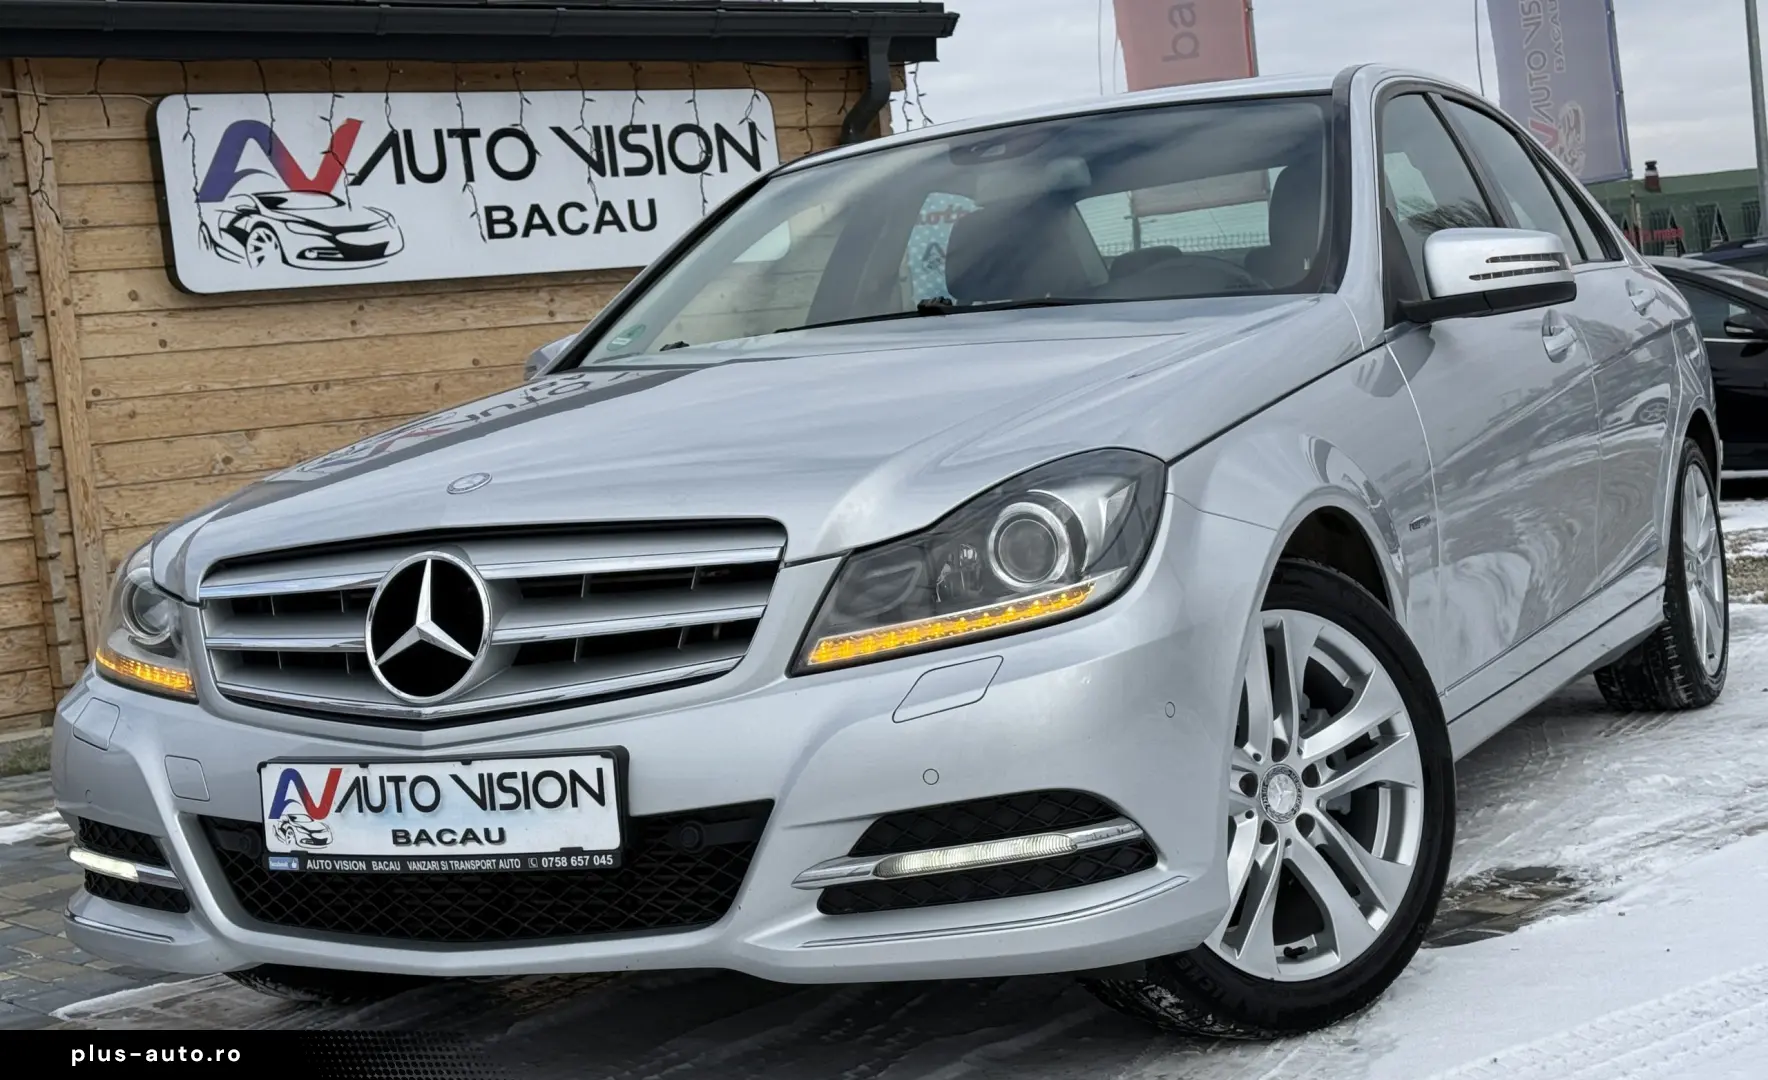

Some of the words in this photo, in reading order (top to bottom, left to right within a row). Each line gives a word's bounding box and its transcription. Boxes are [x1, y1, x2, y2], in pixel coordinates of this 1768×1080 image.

[1526, 50, 1555, 125] AUTO
[347, 126, 541, 188] AUTO
[549, 120, 764, 181] VISION
[484, 198, 658, 240] BACAU
[334, 775, 441, 814] AUTO
[449, 767, 606, 812] VISION
[391, 827, 507, 847] BACAU
[306, 859, 332, 871] AUTO
[333, 860, 367, 871] VISION
[371, 860, 401, 871] BACAU
[406, 860, 440, 872] VANZARI
[440, 860, 449, 871] SI
[449, 858, 497, 871] TRANSPORT
[498, 858, 521, 870] AUTO
[541, 856, 568, 868] 0758
[570, 855, 590, 867] 657
[593, 854, 613, 866] 045
